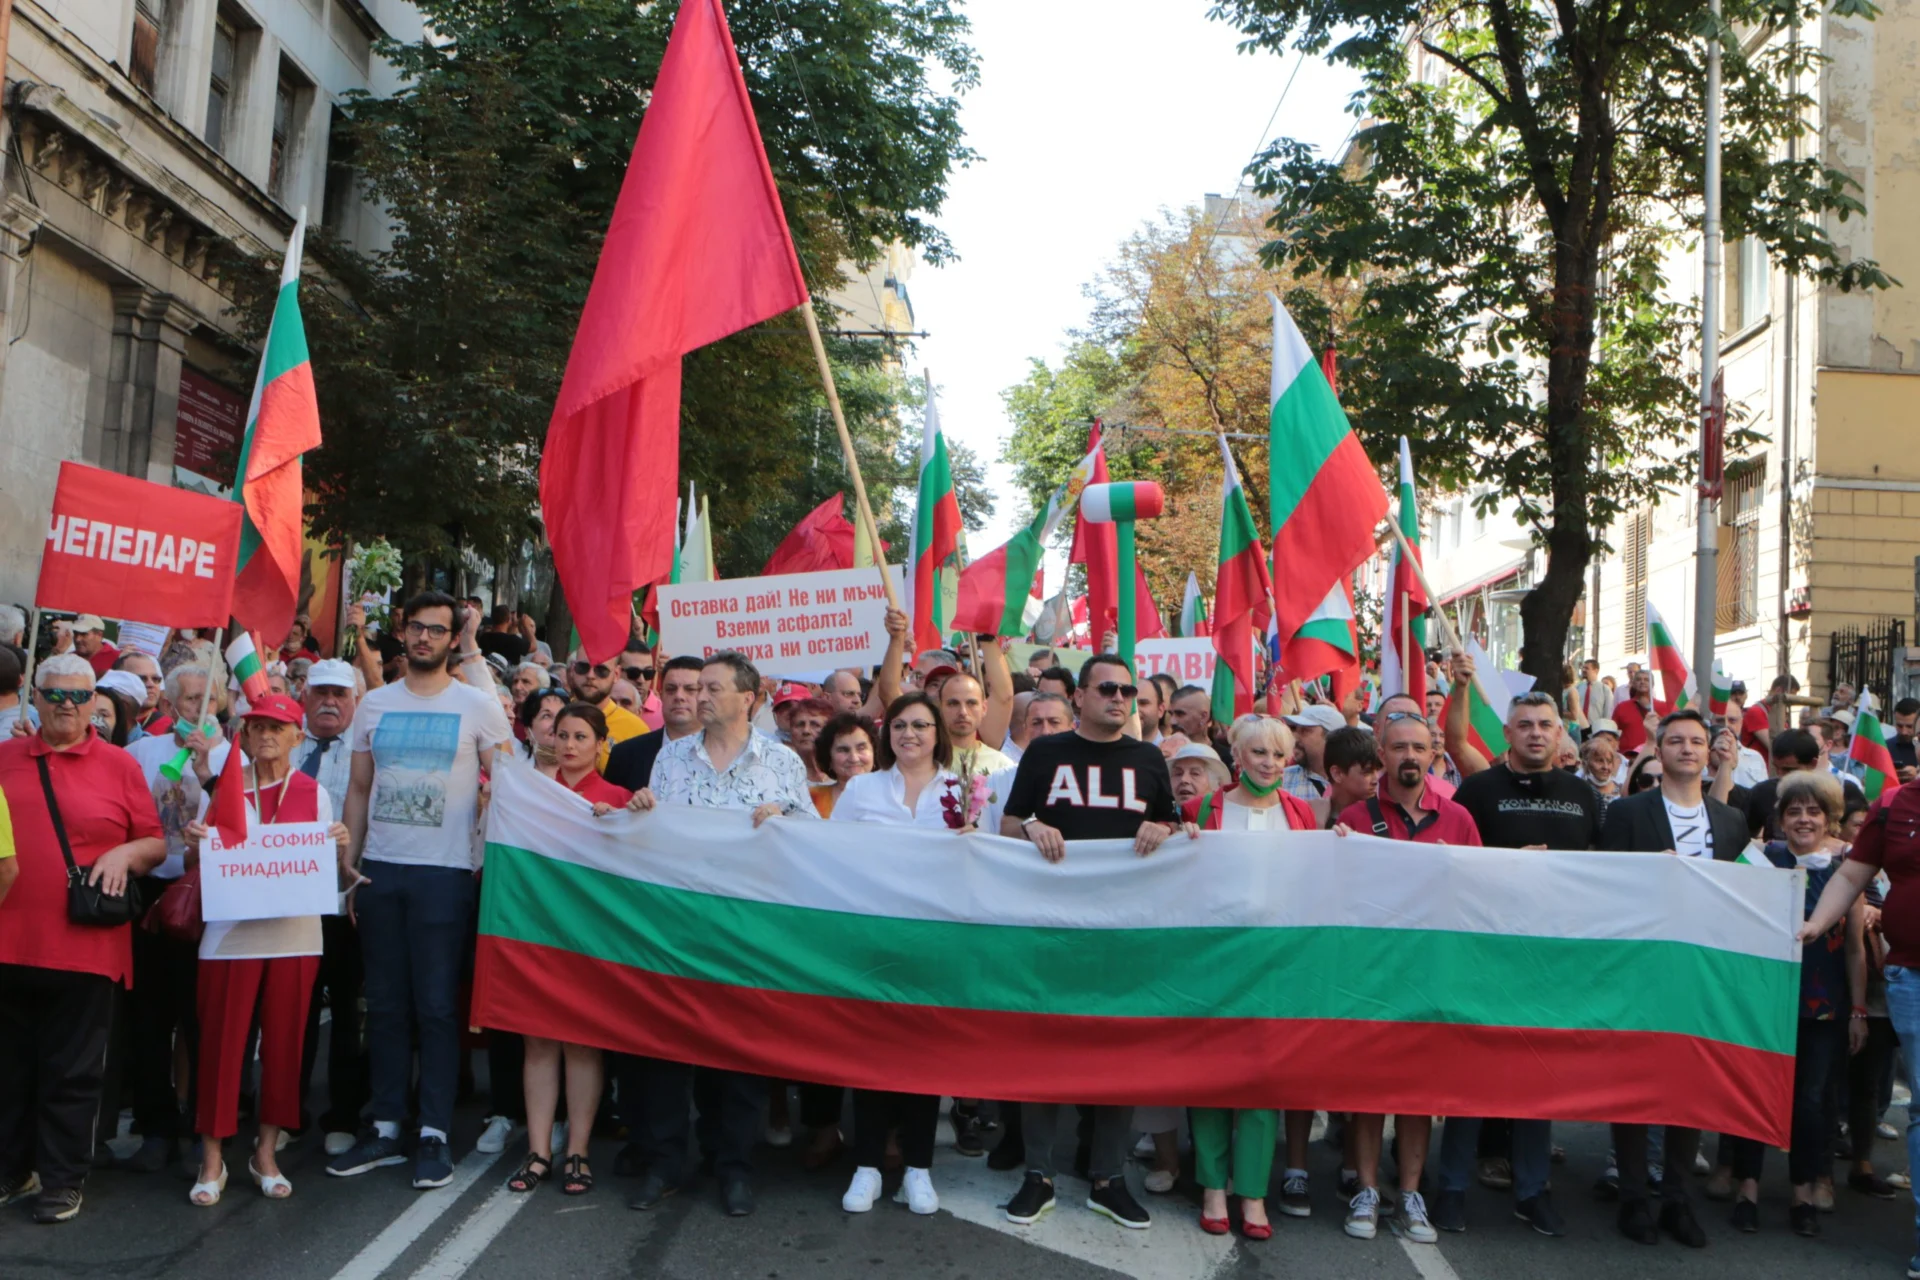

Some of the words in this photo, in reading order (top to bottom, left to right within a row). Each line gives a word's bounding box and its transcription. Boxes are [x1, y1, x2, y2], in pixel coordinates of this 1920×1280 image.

[46, 513, 216, 579] ЧЕПЕЛАРЕ
[671, 597, 739, 618] Оставка
[745, 589, 782, 613] дай!
[788, 587, 809, 607] Не
[816, 588, 837, 605] ни
[843, 584, 888, 602] мъчи
[716, 619, 770, 639] Вземи
[777, 608, 852, 633] асфалта!
[703, 644, 773, 662] Вуха
[780, 641, 801, 657] ни
[808, 631, 870, 655] остави!
[1134, 652, 1217, 680] СТАВК
[1046, 764, 1147, 814] ALL
[1498, 798, 1531, 811] TOM
[1534, 798, 1584, 816] TAILOR
[262, 832, 325, 848] СОФИЯ
[219, 859, 319, 878] ТРИАДИЦА
